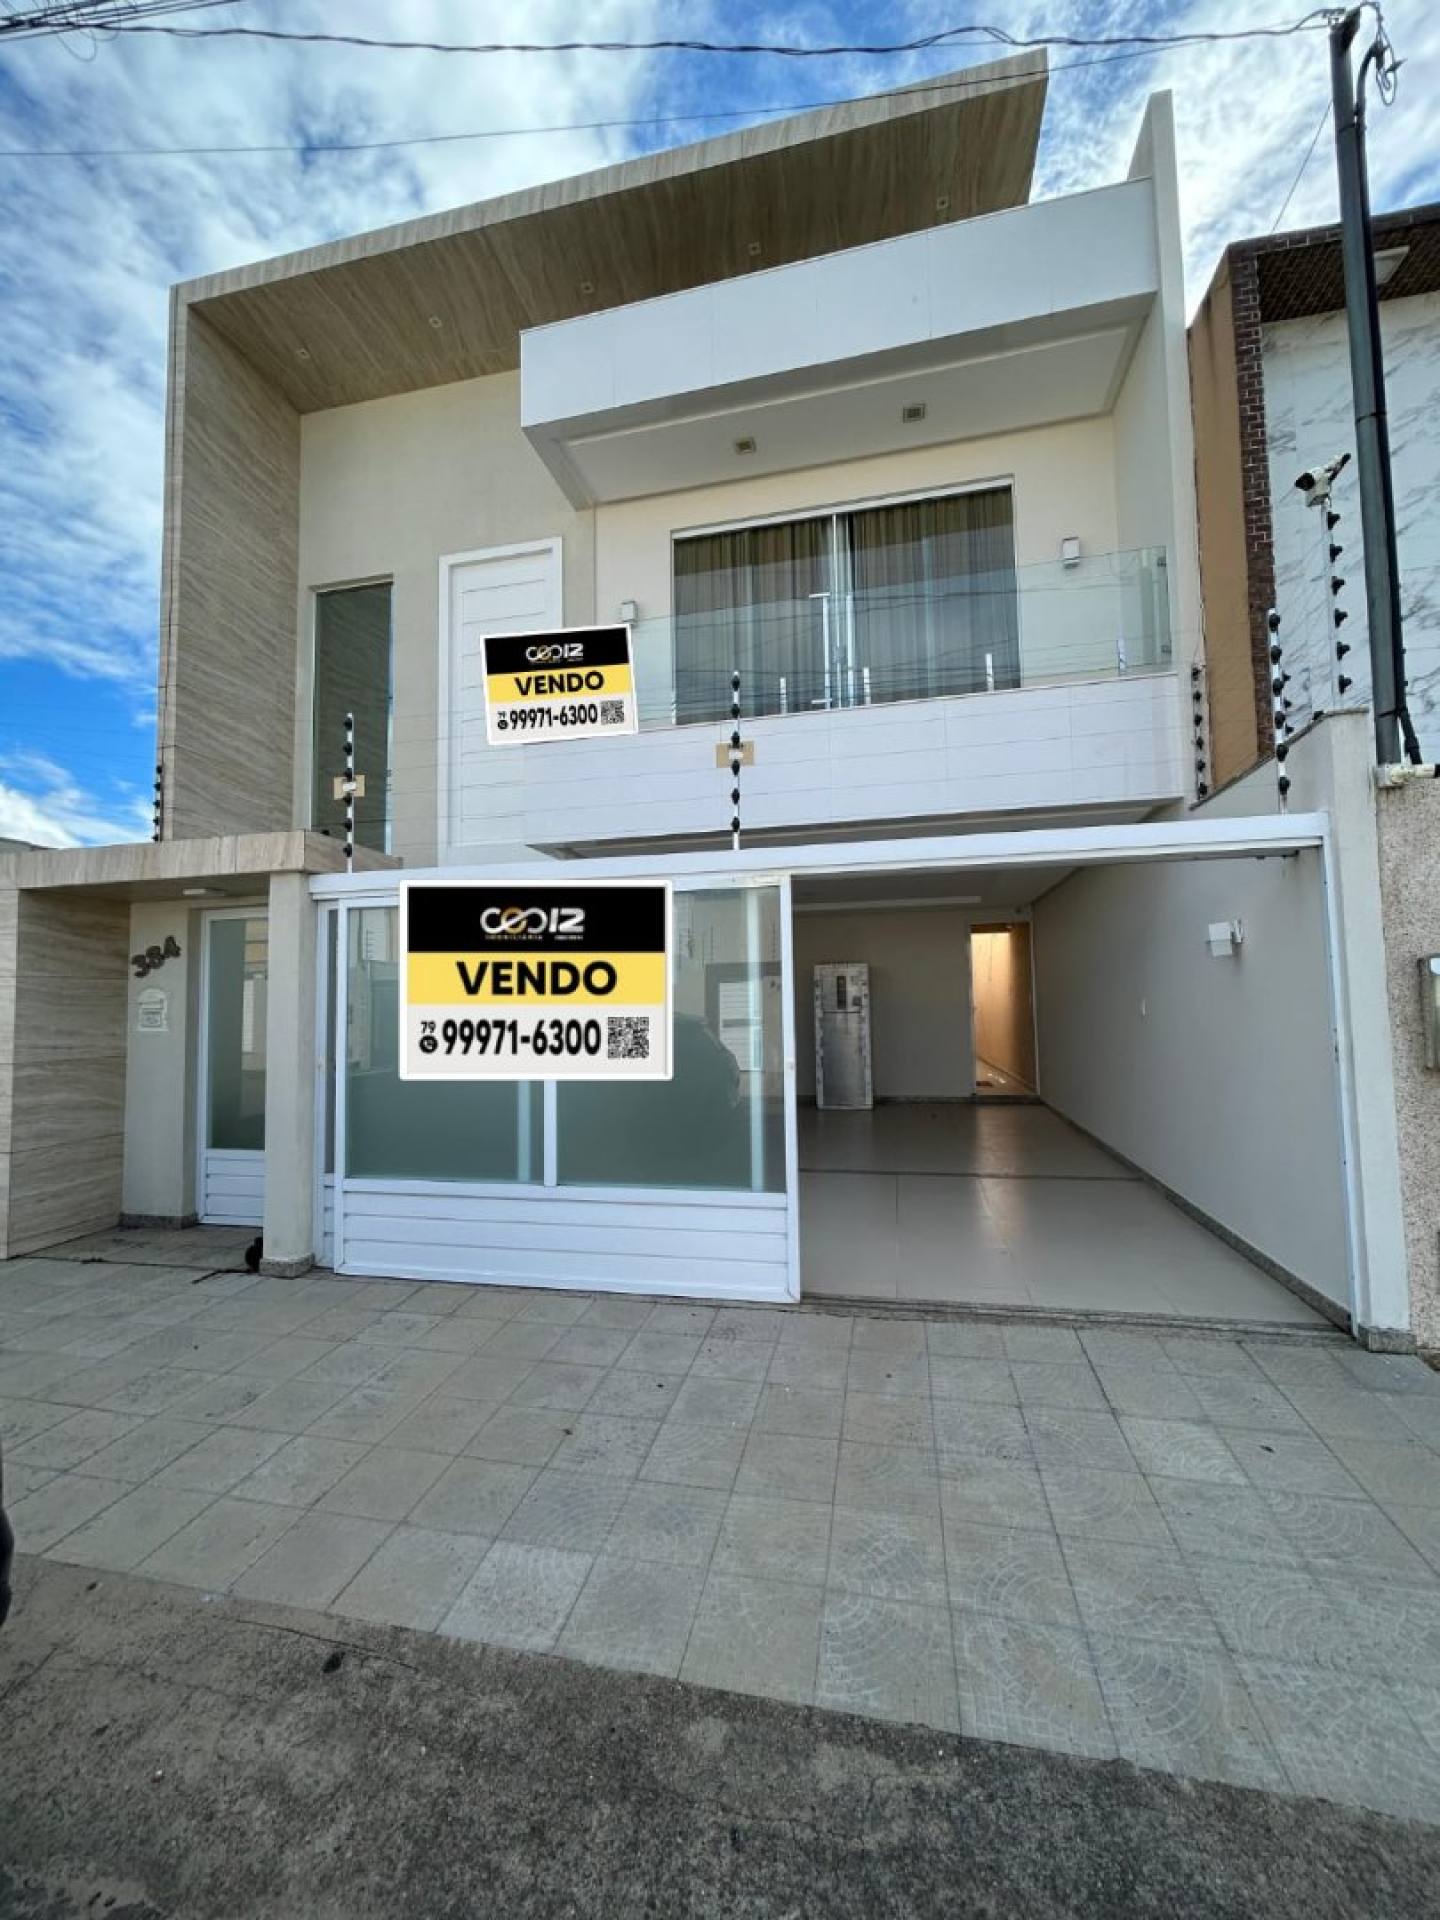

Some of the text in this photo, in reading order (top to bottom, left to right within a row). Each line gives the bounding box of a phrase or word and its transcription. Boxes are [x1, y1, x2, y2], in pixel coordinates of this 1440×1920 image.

[514, 670, 604, 696] VENDO
[509, 703, 598, 730] 99971-6300
[456, 961, 617, 996] VENDO
[420, 1018, 602, 1055] 79 99971-6300
